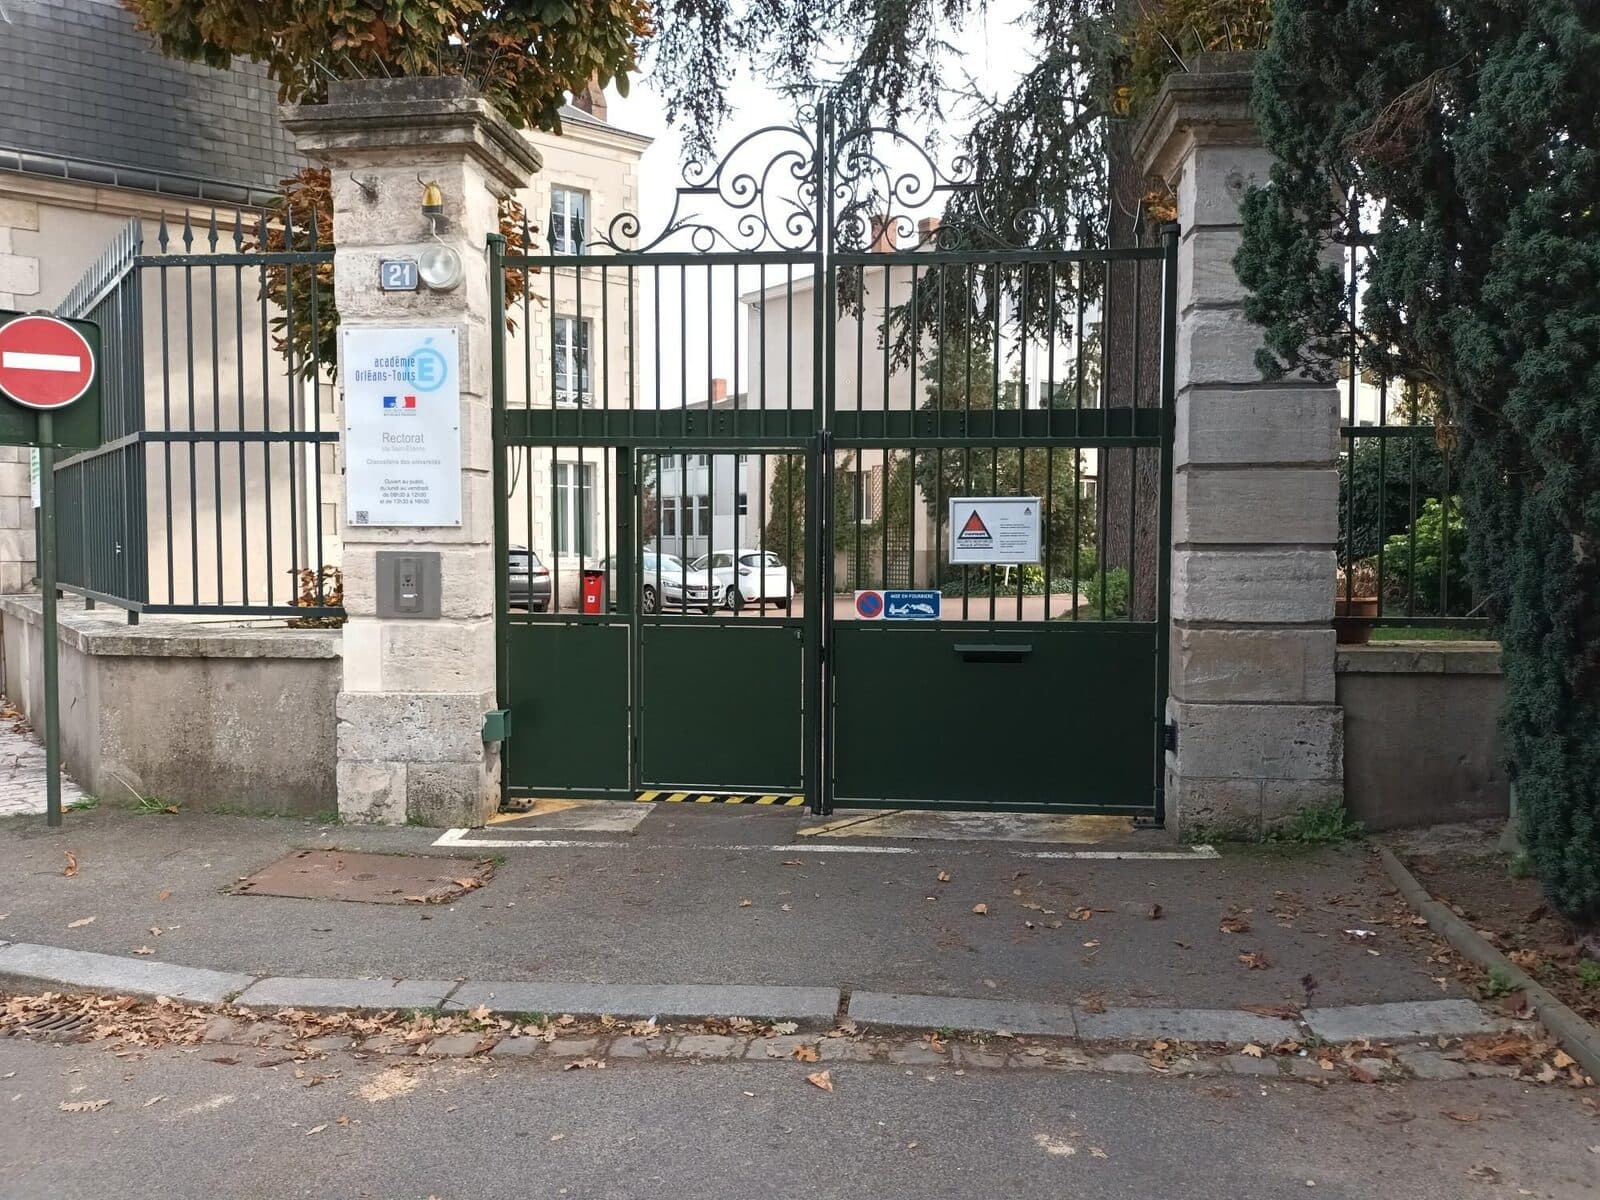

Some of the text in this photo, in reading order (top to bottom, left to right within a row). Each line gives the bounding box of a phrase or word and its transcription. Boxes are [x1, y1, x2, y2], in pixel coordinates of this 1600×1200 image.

[389, 264, 410, 286] 21
[374, 356, 416, 368] académie
[355, 369, 416, 382] Orléans-Tours
[382, 432, 424, 444] Rectorat
